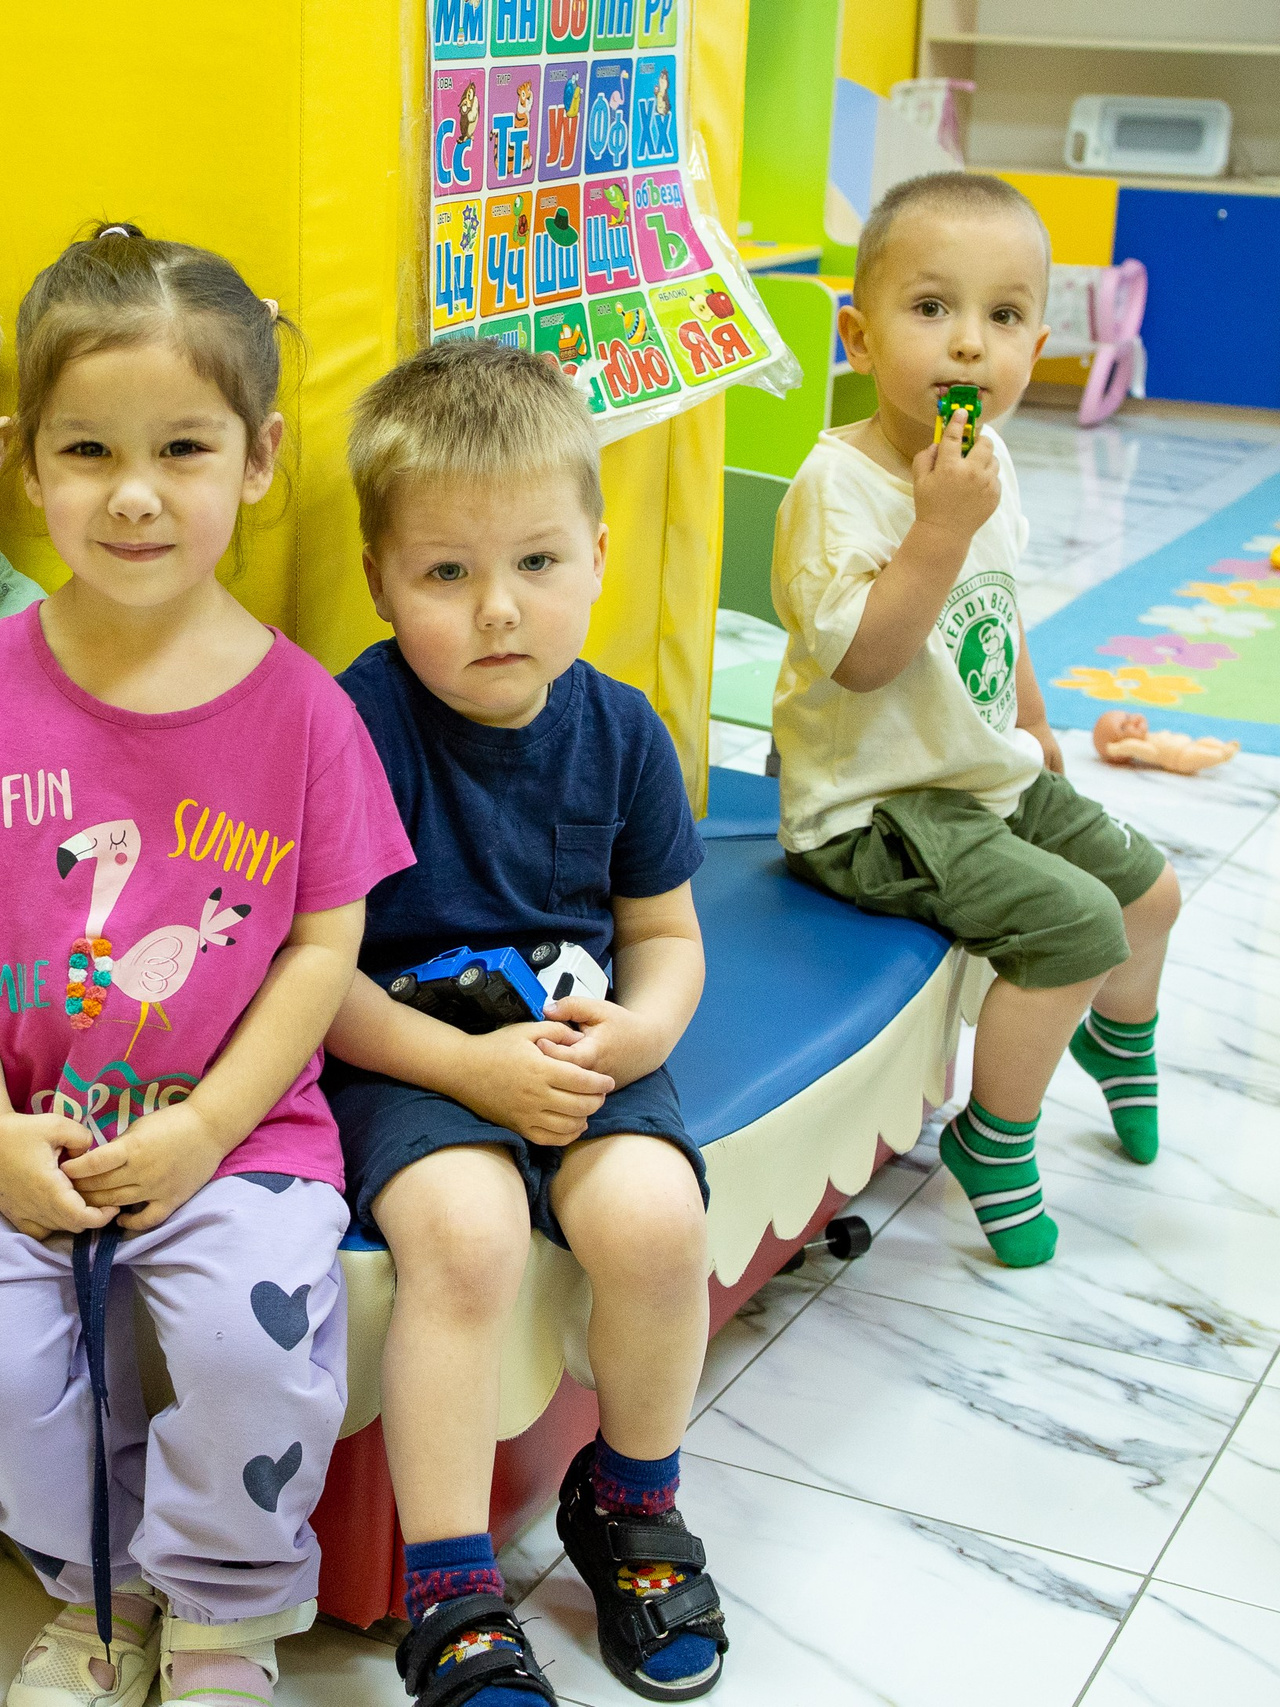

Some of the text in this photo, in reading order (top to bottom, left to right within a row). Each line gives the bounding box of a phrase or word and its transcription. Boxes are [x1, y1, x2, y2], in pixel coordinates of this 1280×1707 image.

[492, 113, 529, 180] Тт
[588, 92, 628, 167] Фф
[487, 233, 526, 308] Чч
[586, 214, 637, 284] Щщ
[645, 212, 689, 272] Ъ
[435, 241, 475, 317] Цц
[658, 287, 689, 302] ЯБЛОКО
[677, 320, 753, 376] Яя
[1, 768, 73, 829] FUN
[168, 798, 295, 886] SUNNY
